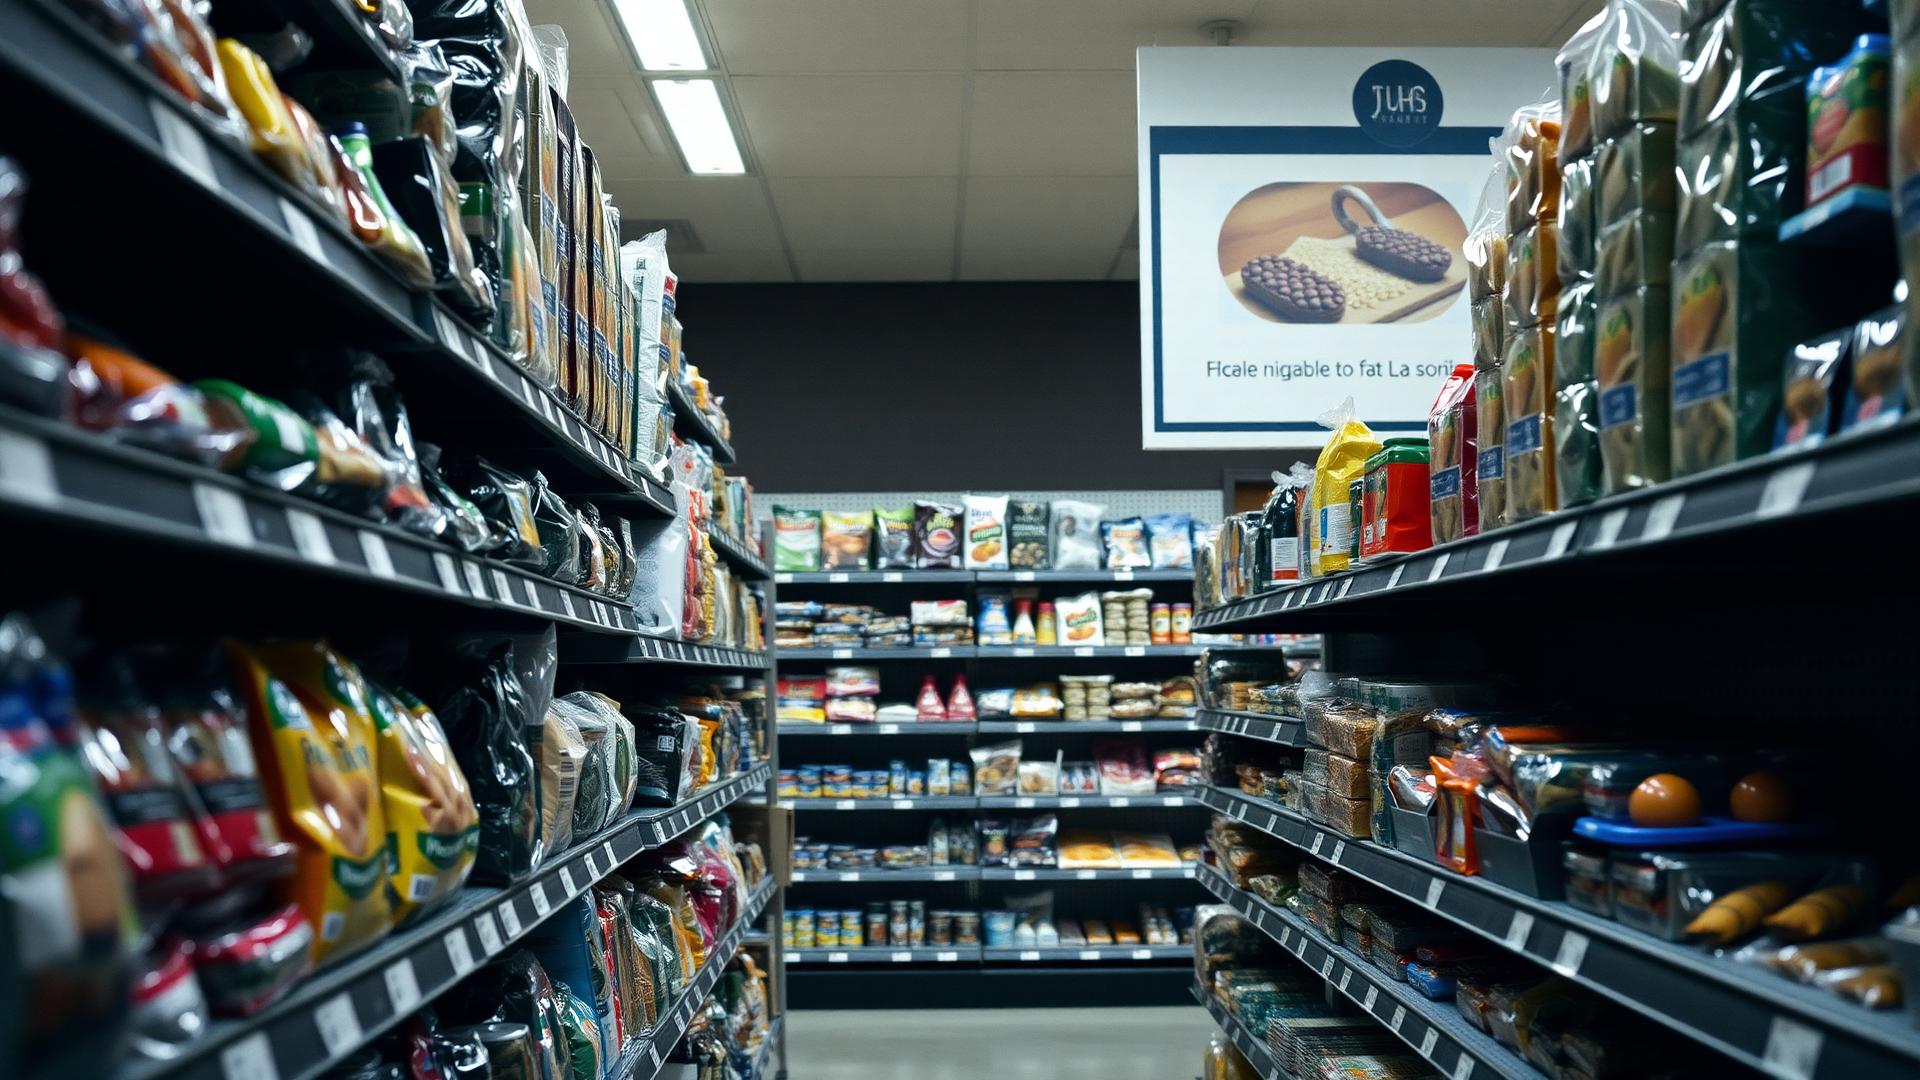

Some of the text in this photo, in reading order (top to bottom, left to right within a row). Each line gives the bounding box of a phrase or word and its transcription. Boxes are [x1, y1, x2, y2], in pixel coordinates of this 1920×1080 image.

[1263, 360, 1331, 382] nigable
[1335, 361, 1354, 377] to
[1359, 359, 1383, 377] fat
[1388, 360, 1410, 377] La
